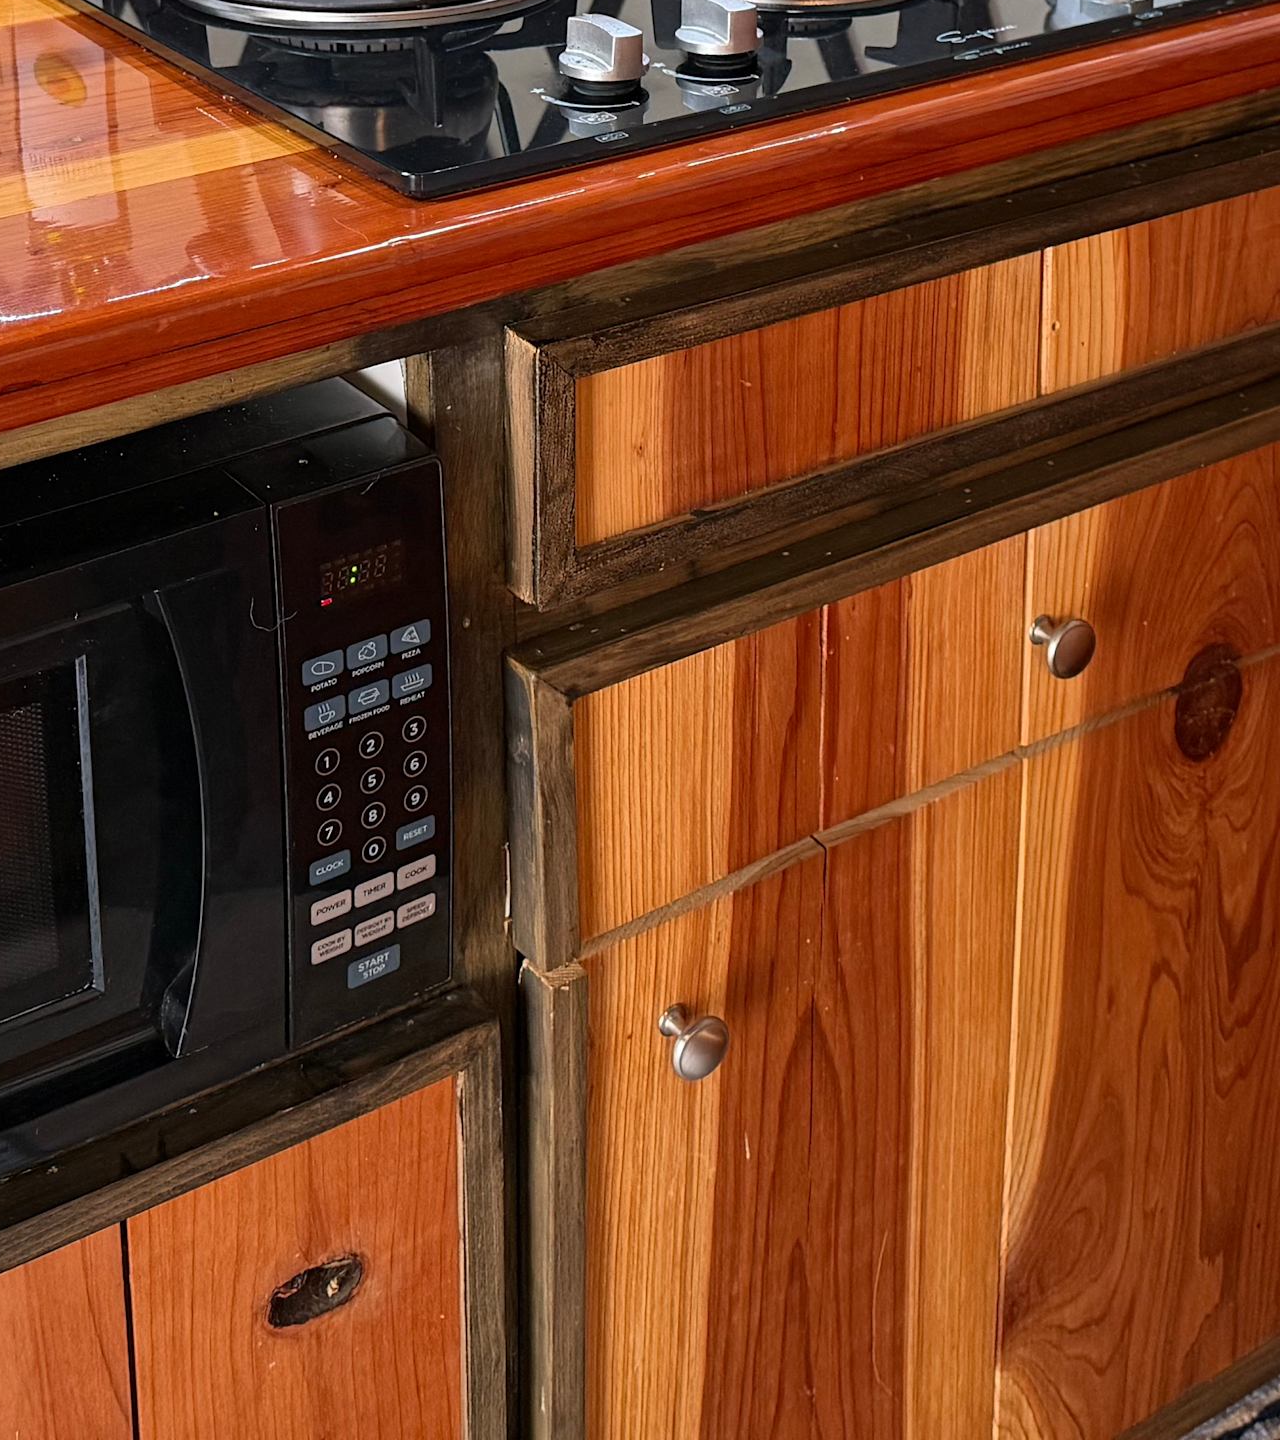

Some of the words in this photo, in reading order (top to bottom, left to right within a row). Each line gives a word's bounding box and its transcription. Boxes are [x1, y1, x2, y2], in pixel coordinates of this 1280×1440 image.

[401, 648, 421, 660] PIZZA
[351, 661, 385, 677] POPCORN
[310, 678, 338, 692] POTATO
[400, 691, 426, 705] REHEAT
[348, 710, 373, 724] FROZEN
[373, 704, 391, 716] FOOD
[308, 721, 344, 740] BEVERAGE
[409, 722, 419, 737] 3
[366, 738, 376, 753] 2
[323, 756, 330, 769] 1
[410, 757, 419, 771] 6
[367, 773, 377, 788] 5
[323, 790, 334, 804] 4
[410, 792, 420, 806] 9
[368, 809, 378, 823] 8
[325, 825, 334, 840] 7
[403, 824, 428, 841] RESET
[368, 843, 379, 857] 0
[316, 859, 344, 876] CLOCK
[404, 864, 428, 879] COOK
[363, 882, 387, 897] TIMER
[316, 899, 346, 916] POWER
[401, 905, 430, 923] DEFROST
[406, 901, 426, 913] SPEED
[362, 925, 387, 939] WEIGHT
[317, 940, 336, 951] COOK
[337, 935, 345, 943] BY
[319, 942, 345, 957] WEIGHT
[358, 952, 390, 972] START
[362, 963, 386, 980] STOP
